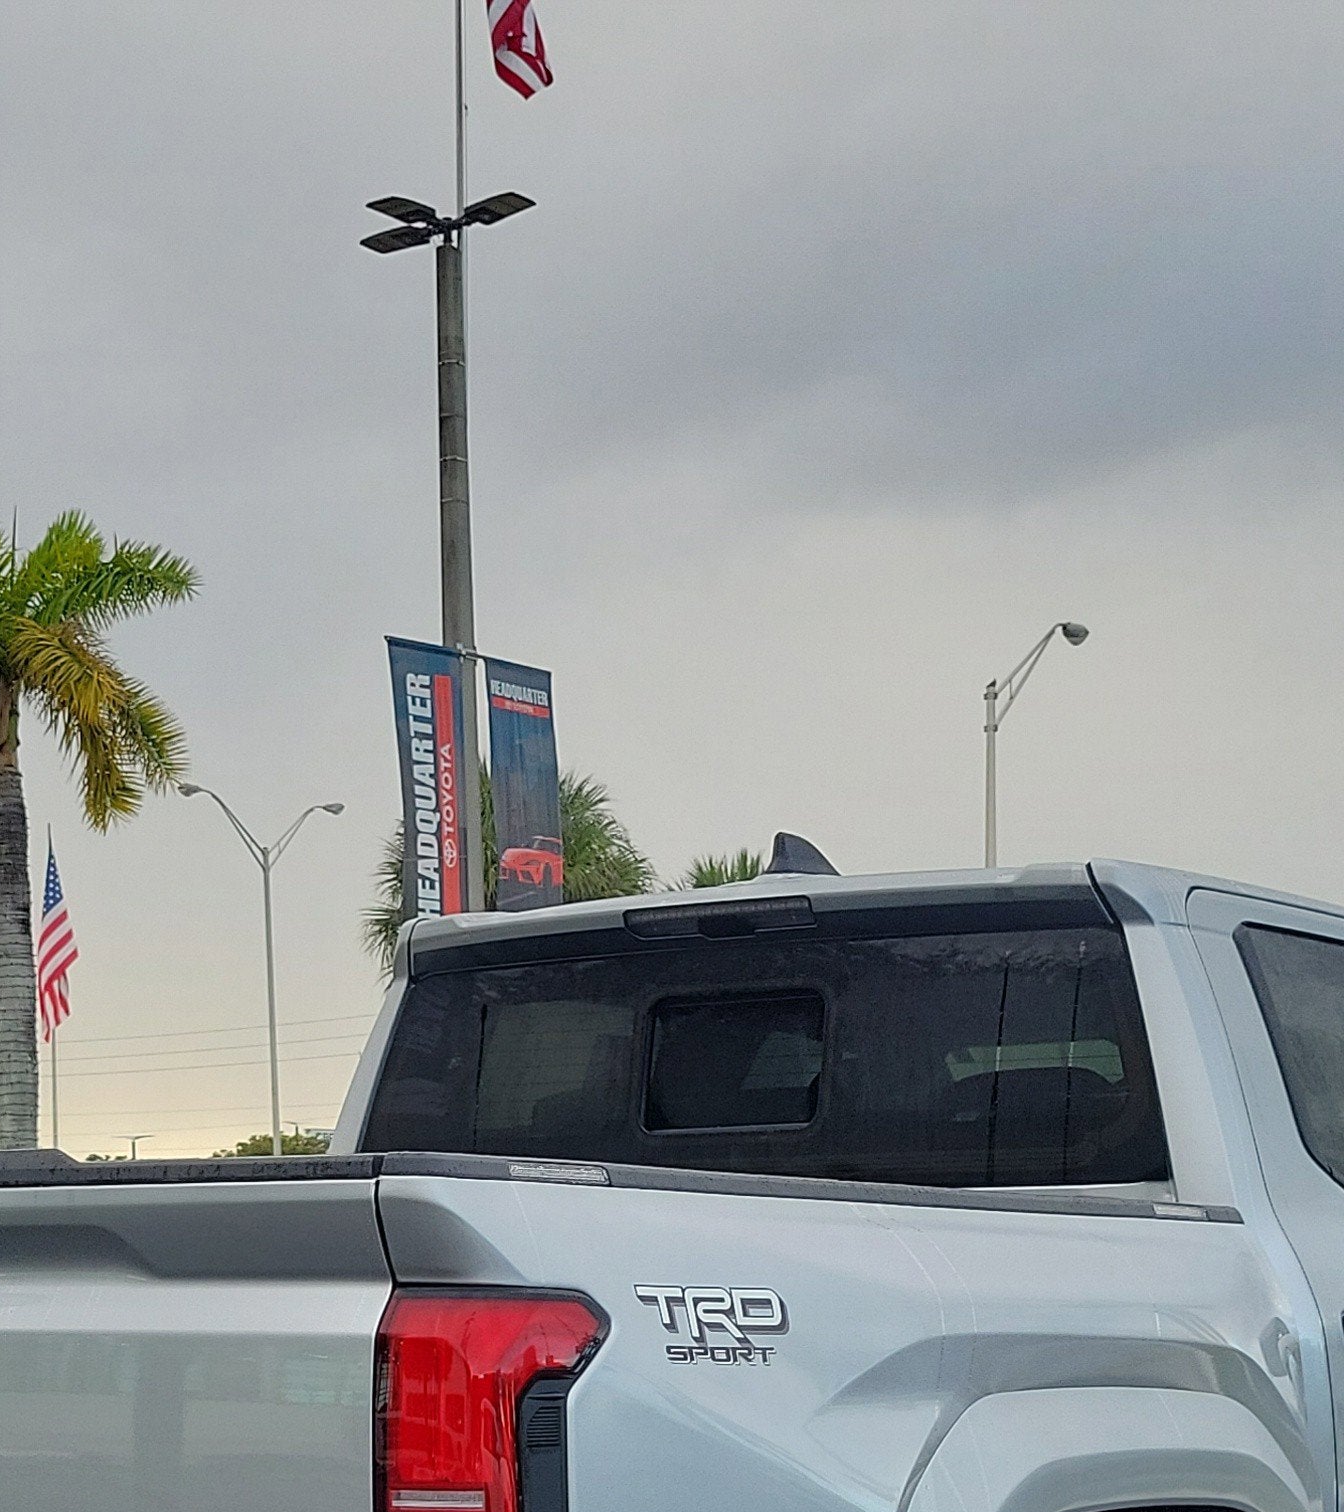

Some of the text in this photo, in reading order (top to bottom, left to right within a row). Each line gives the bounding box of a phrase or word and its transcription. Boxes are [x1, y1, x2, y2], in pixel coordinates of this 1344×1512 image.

[405, 672, 442, 917] HEADQUARTER
[439, 742, 455, 831] TOYOTA
[634, 1284, 790, 1346] TRD
[665, 1345, 776, 1366] SPORT
